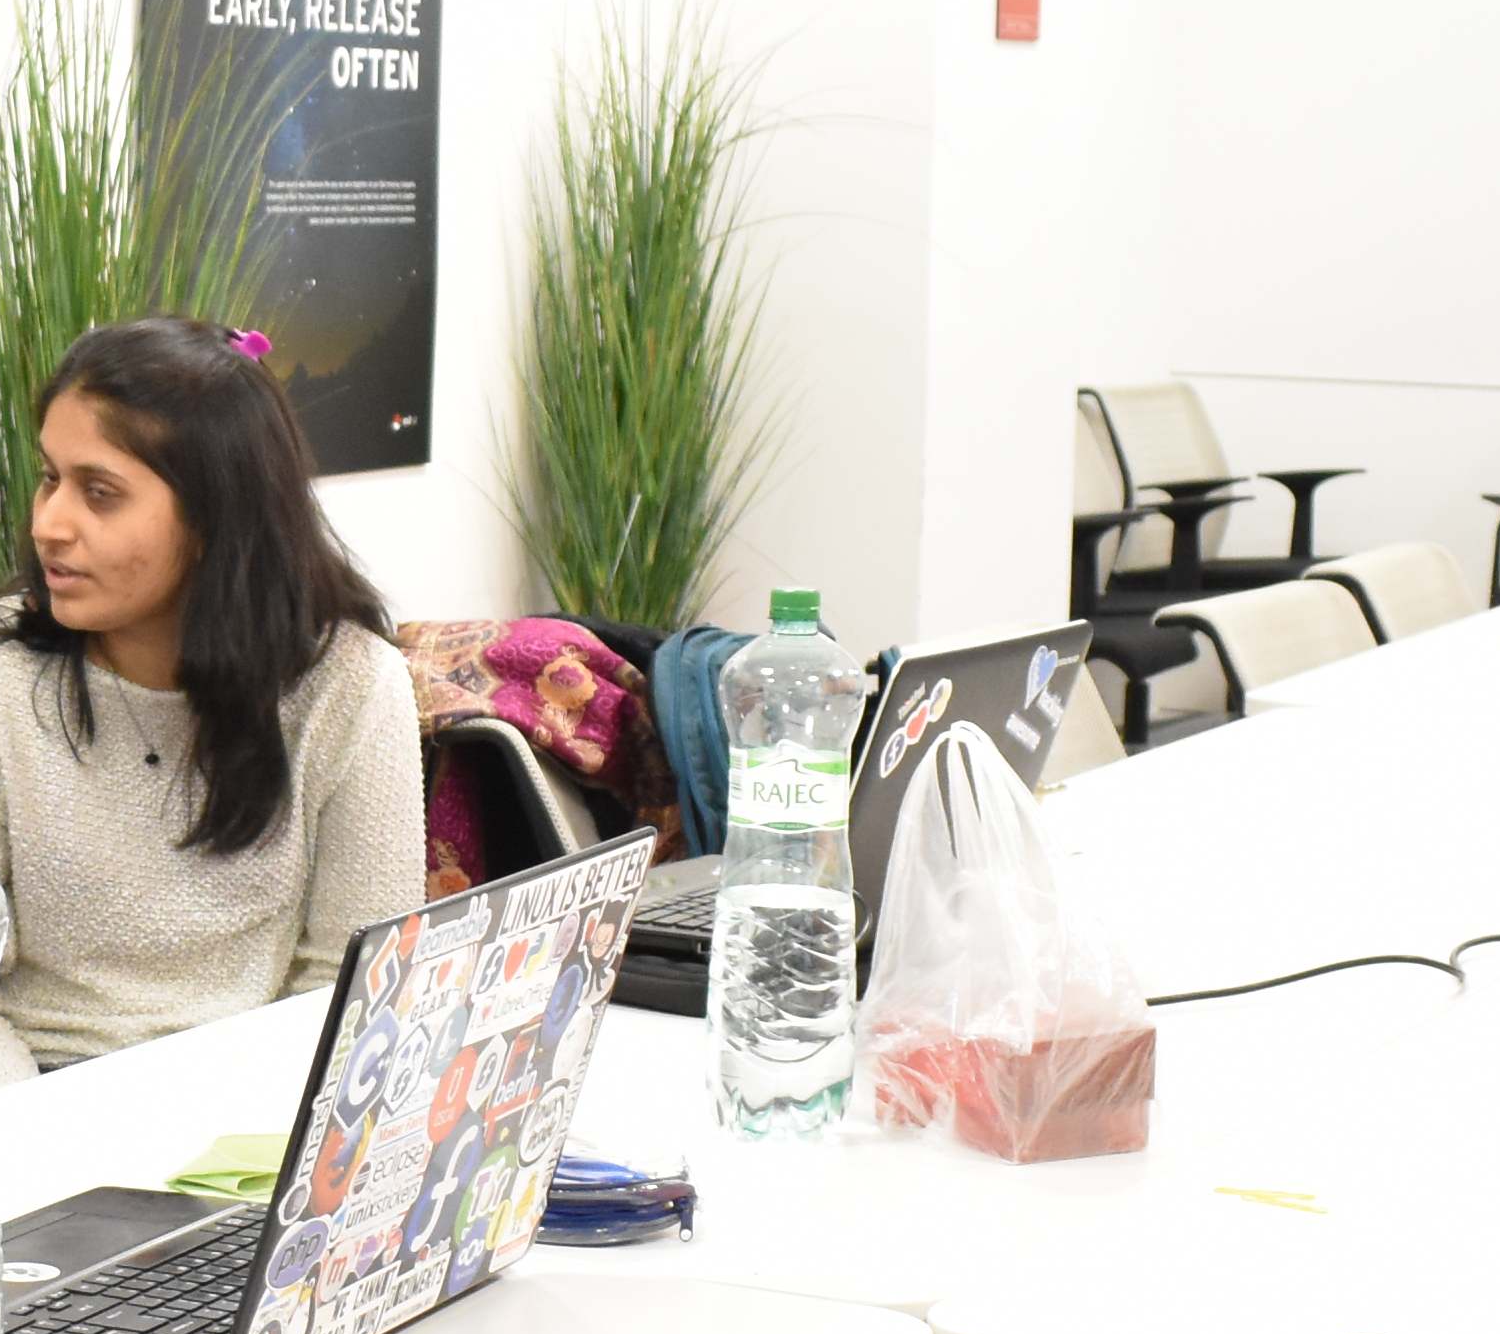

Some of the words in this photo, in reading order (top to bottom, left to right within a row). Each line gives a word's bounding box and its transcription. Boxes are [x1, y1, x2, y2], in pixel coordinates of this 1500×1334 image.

[330, 45, 420, 91] OFTEN
[752, 781, 828, 810] RAJEC
[499, 873, 563, 936] LINUX
[579, 843, 649, 906] BETTER
[371, 1141, 427, 1185] eclipse
[275, 1232, 322, 1280] php
